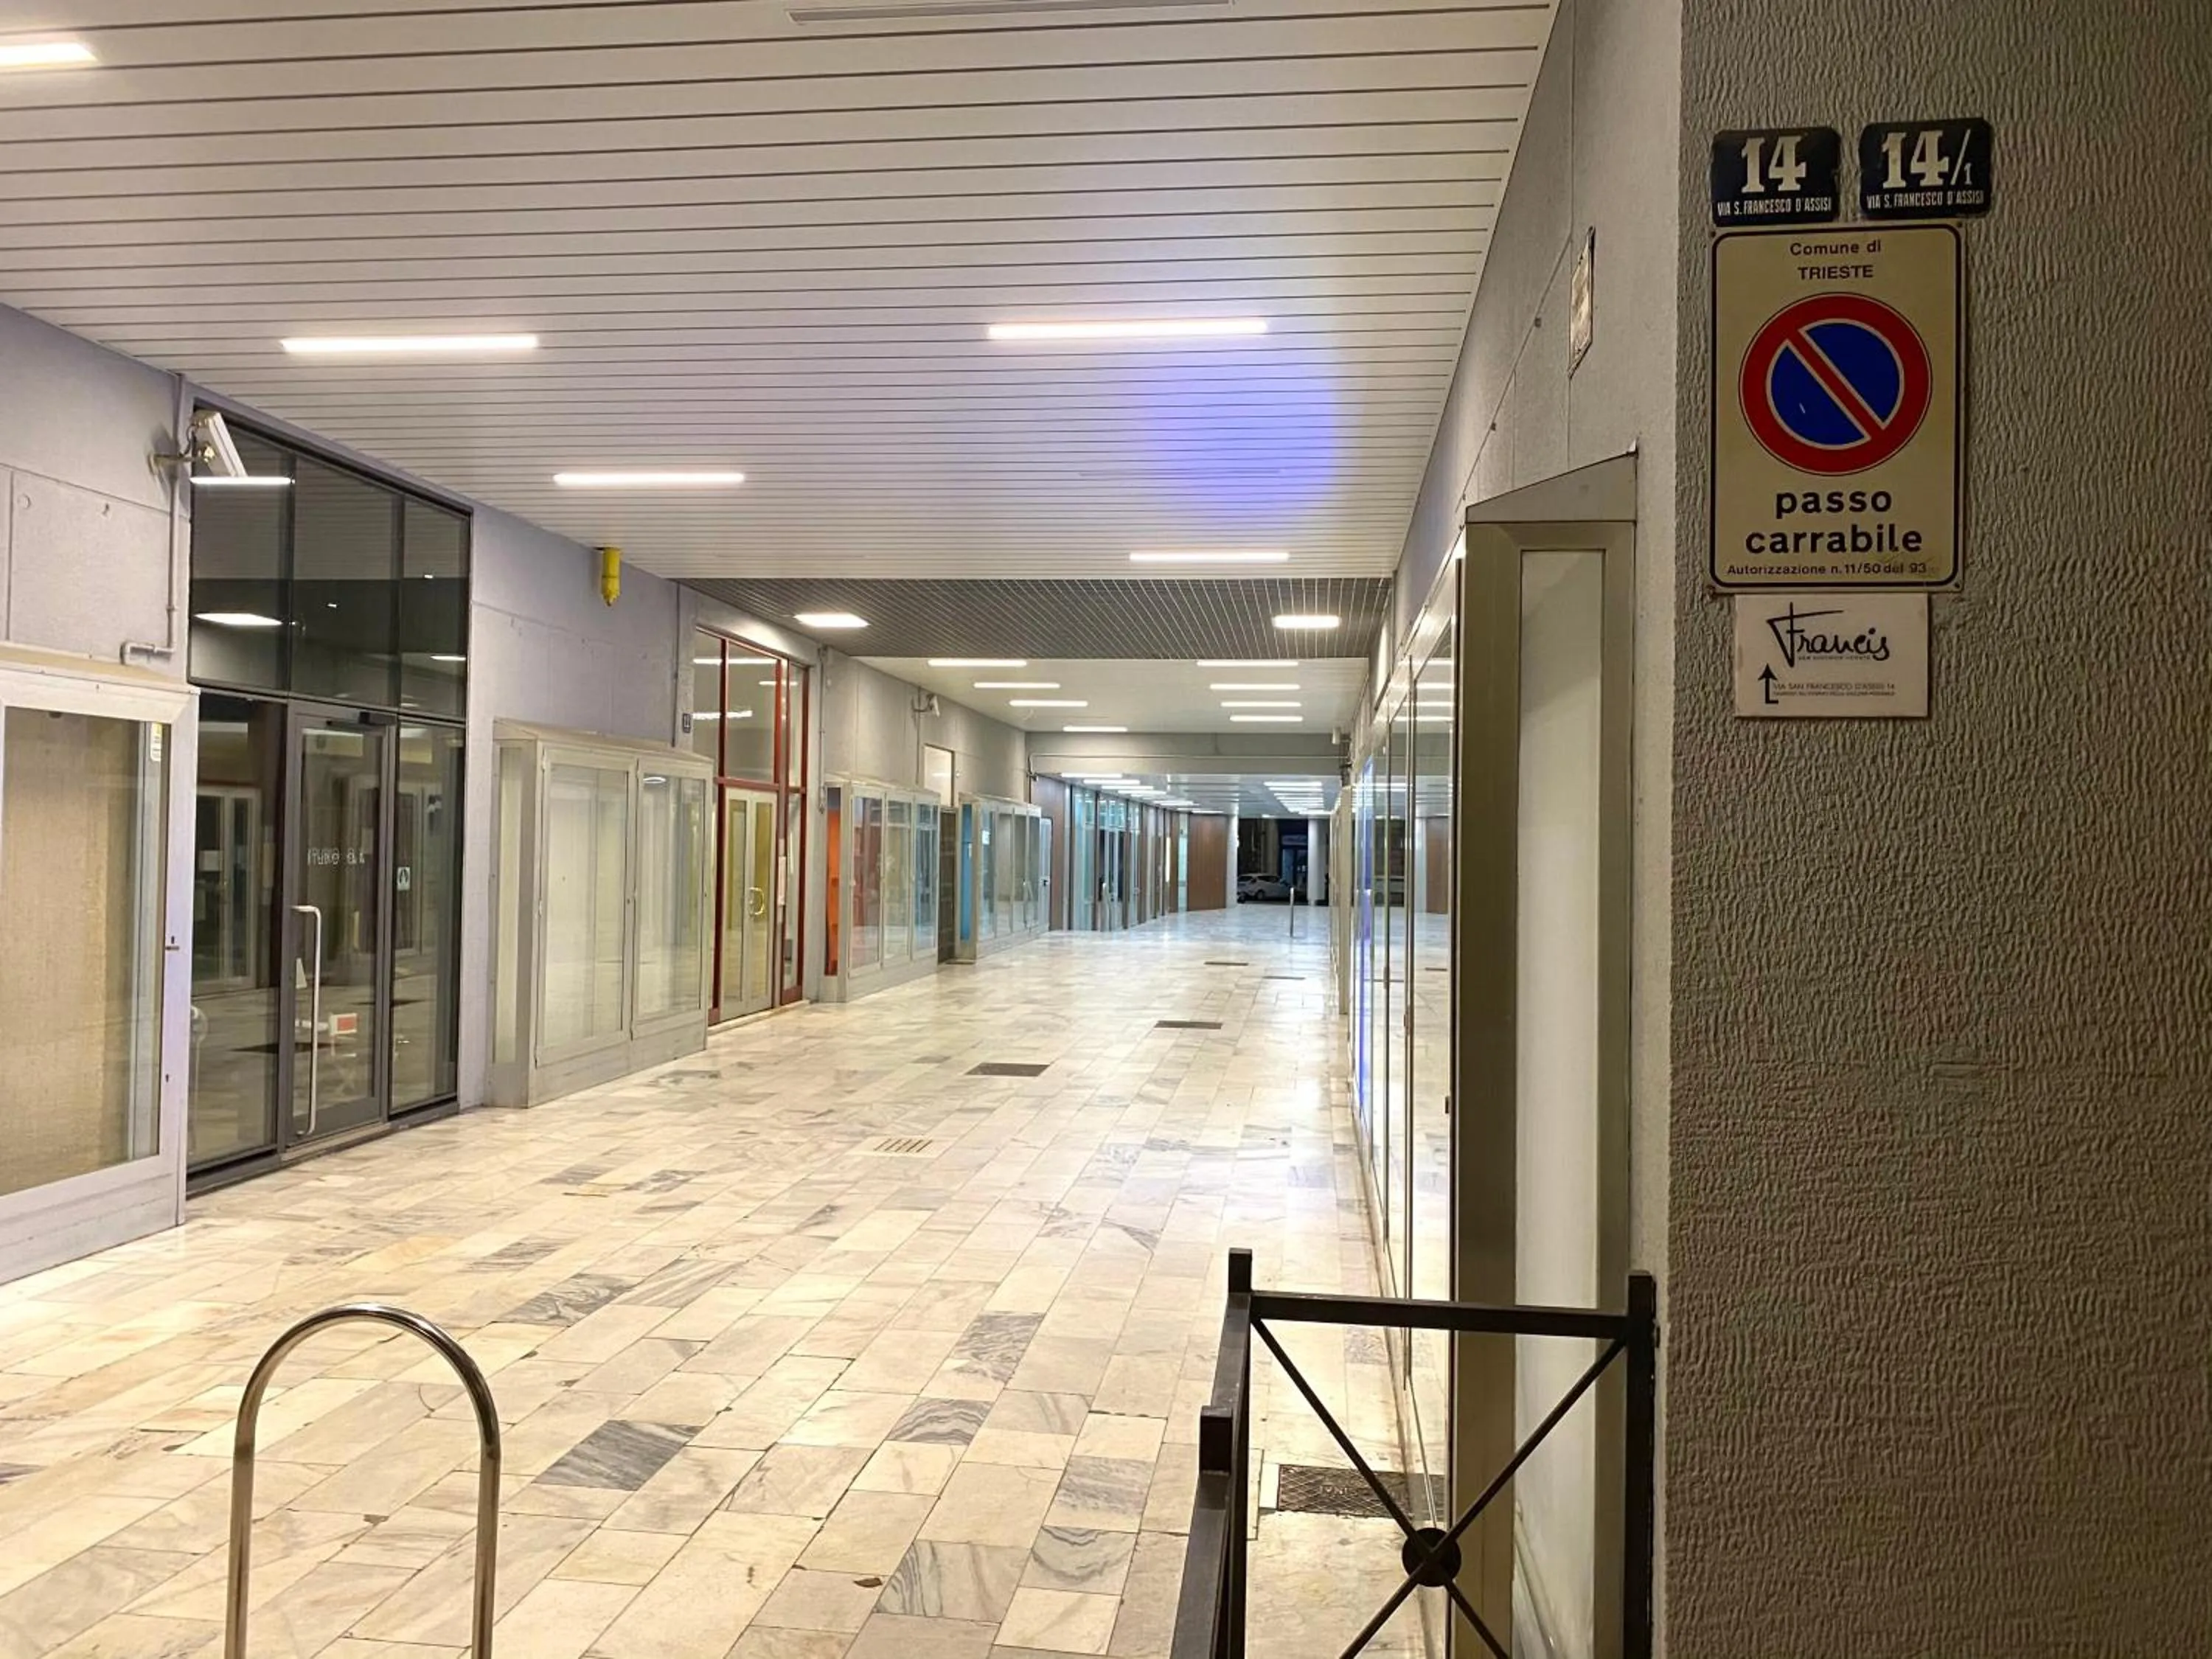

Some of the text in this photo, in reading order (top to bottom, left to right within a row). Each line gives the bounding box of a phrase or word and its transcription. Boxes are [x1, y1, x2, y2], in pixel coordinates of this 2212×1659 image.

[1741, 135, 1806, 194] 14
[1717, 196, 1832, 217] VIA S. FRANCESCO D'ASSISI
[1866, 189, 1984, 210] VIA S. FRANCESCO D'ASSISI
[1790, 240, 1882, 257] Comune di
[1798, 264, 1874, 280] TRIESTE
[1775, 490, 1893, 520] passo
[1745, 523, 1923, 554] carrabile
[1727, 564, 1826, 576] Autorizzazione
[1831, 565, 1843, 575] n.
[1909, 563, 1927, 574] 93
[1765, 601, 1891, 669] Francis
